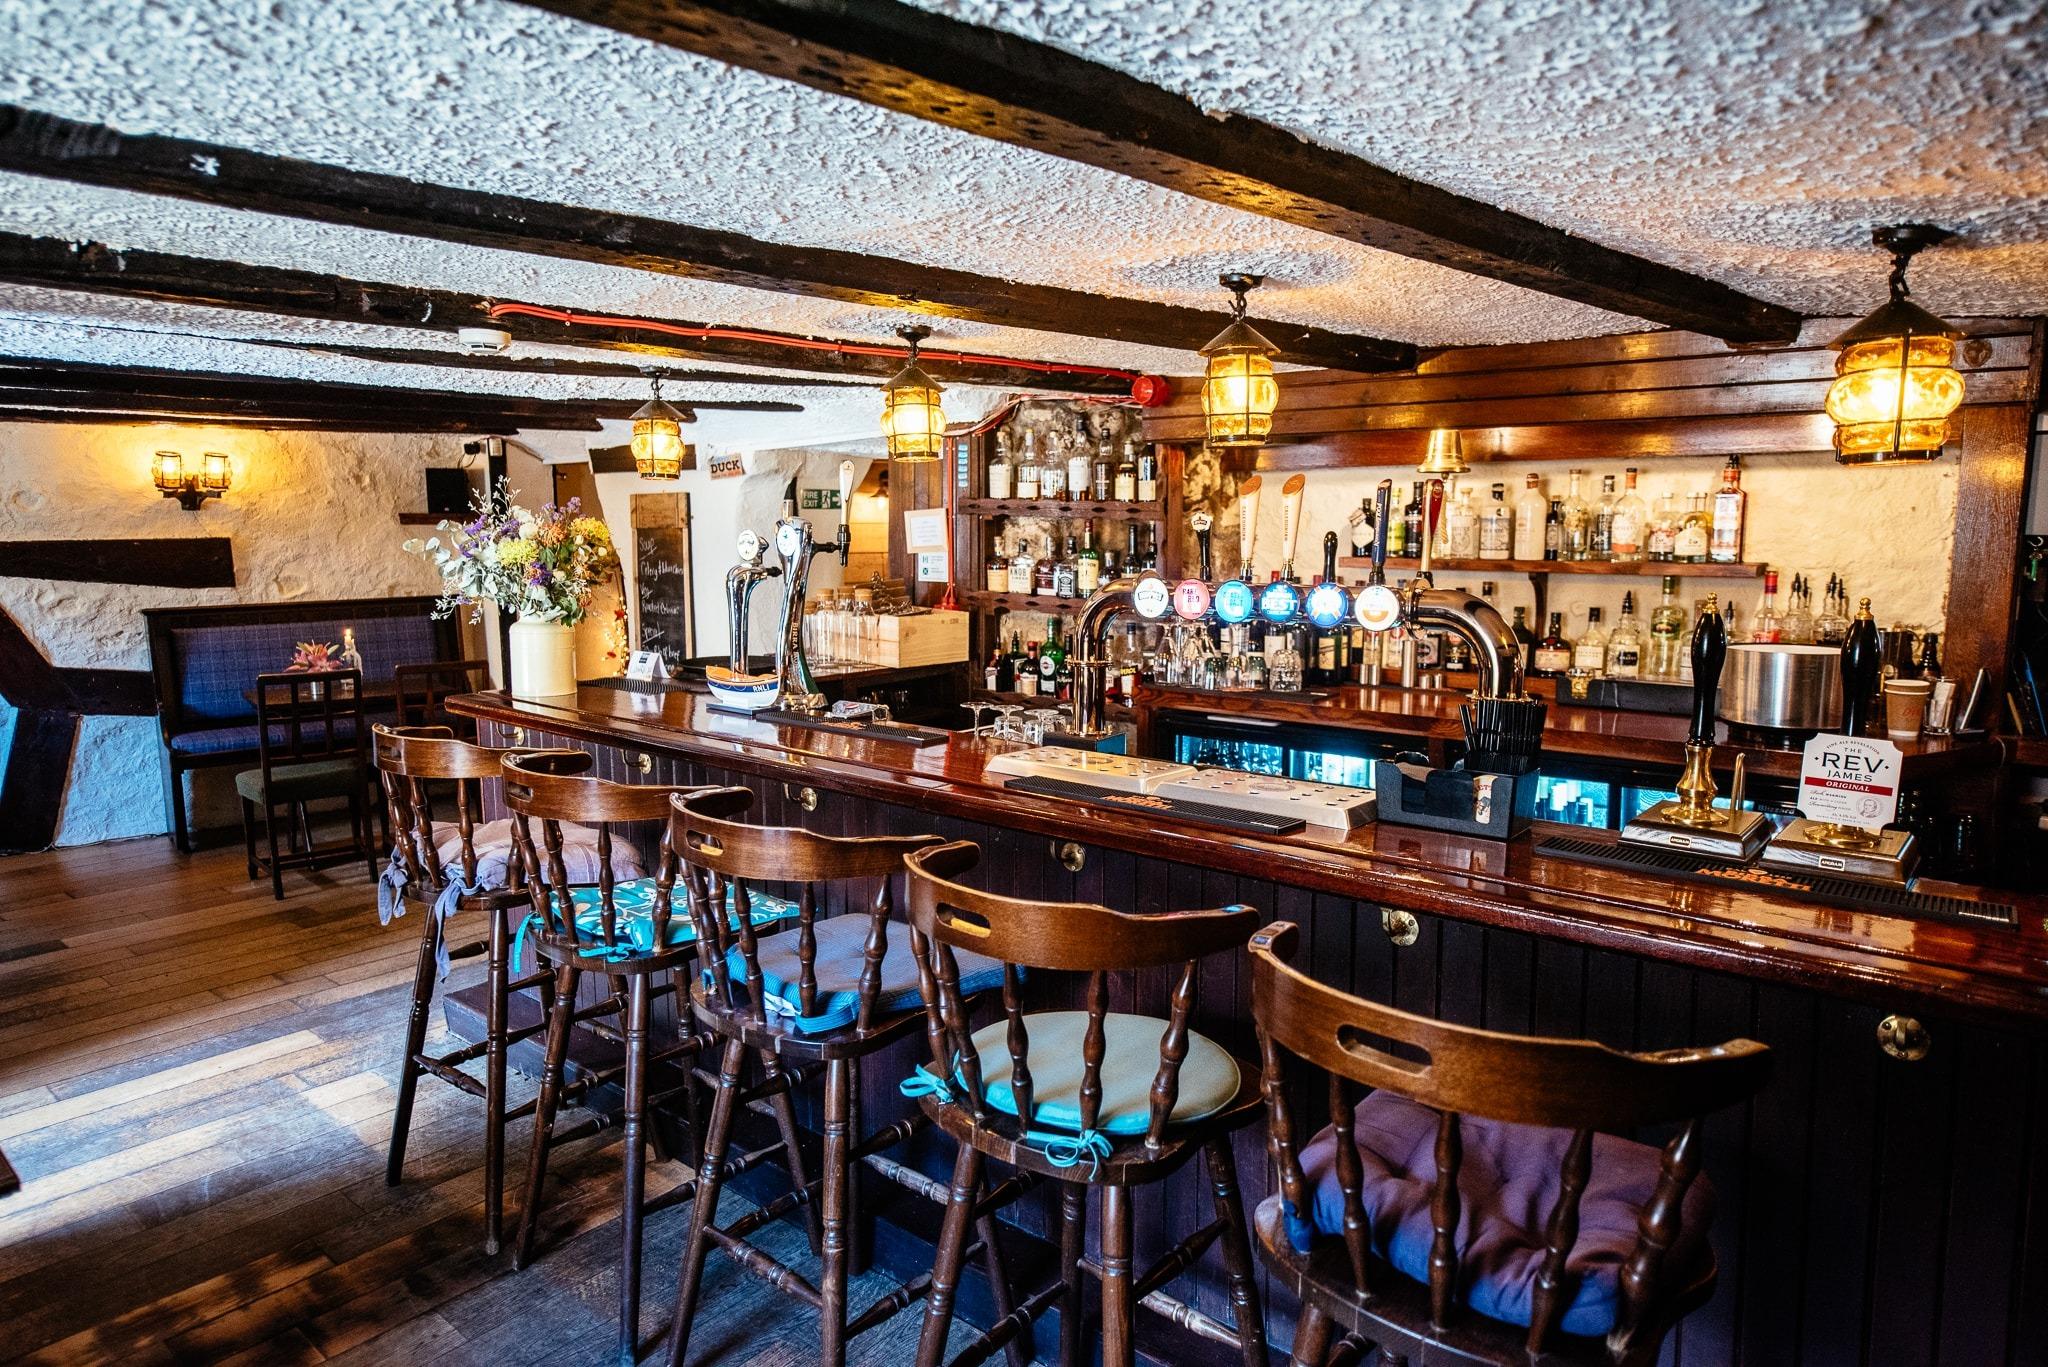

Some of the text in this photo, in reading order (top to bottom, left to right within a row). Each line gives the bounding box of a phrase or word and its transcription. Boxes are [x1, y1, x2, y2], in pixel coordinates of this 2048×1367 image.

[710, 459, 740, 474] DUCK
[803, 491, 818, 499] FIRE
[803, 500, 818, 508] EXIT
[791, 622, 799, 650] BIRRA
[752, 683, 770, 693] RNLI
[1850, 740, 1880, 755] REVELATION
[1822, 752, 1884, 773] REV
[1827, 770, 1873, 783] JAMES
[1825, 780, 1870, 792] ORIGINAL
